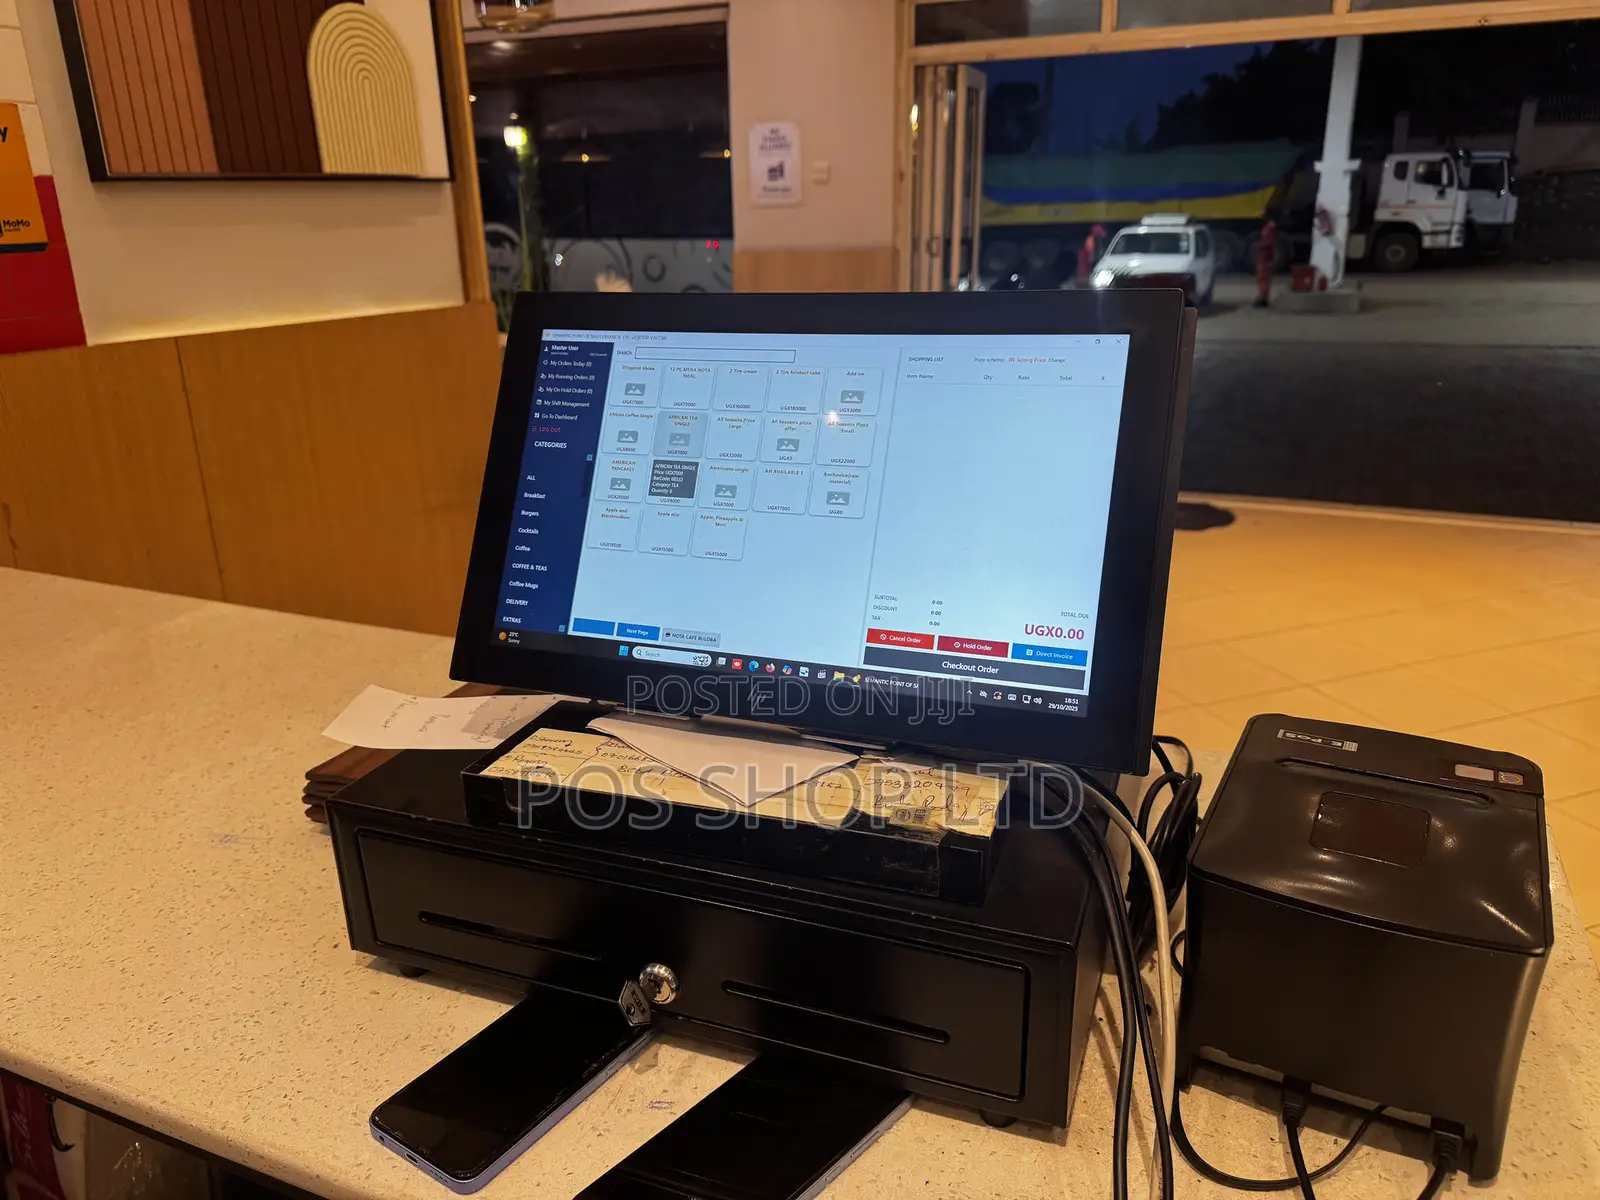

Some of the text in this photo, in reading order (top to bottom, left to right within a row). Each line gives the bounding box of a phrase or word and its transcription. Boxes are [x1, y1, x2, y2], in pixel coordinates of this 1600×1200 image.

[3, 219, 30, 229] MoMo
[534, 440, 567, 449] CATEGORIES
[512, 562, 530, 570] COFFEE
[509, 580, 539, 590] Coffee Mugs
[506, 598, 529, 606] DELIVERY
[872, 604, 898, 612] DISCOUNT
[502, 616, 522, 624] EXTRAS
[1024, 624, 1085, 640] UGX0.00
[1036, 650, 1073, 660] Direct Invoice
[942, 660, 1000, 674] Checkout Order
[864, 677, 889, 686] SEMANTIC
